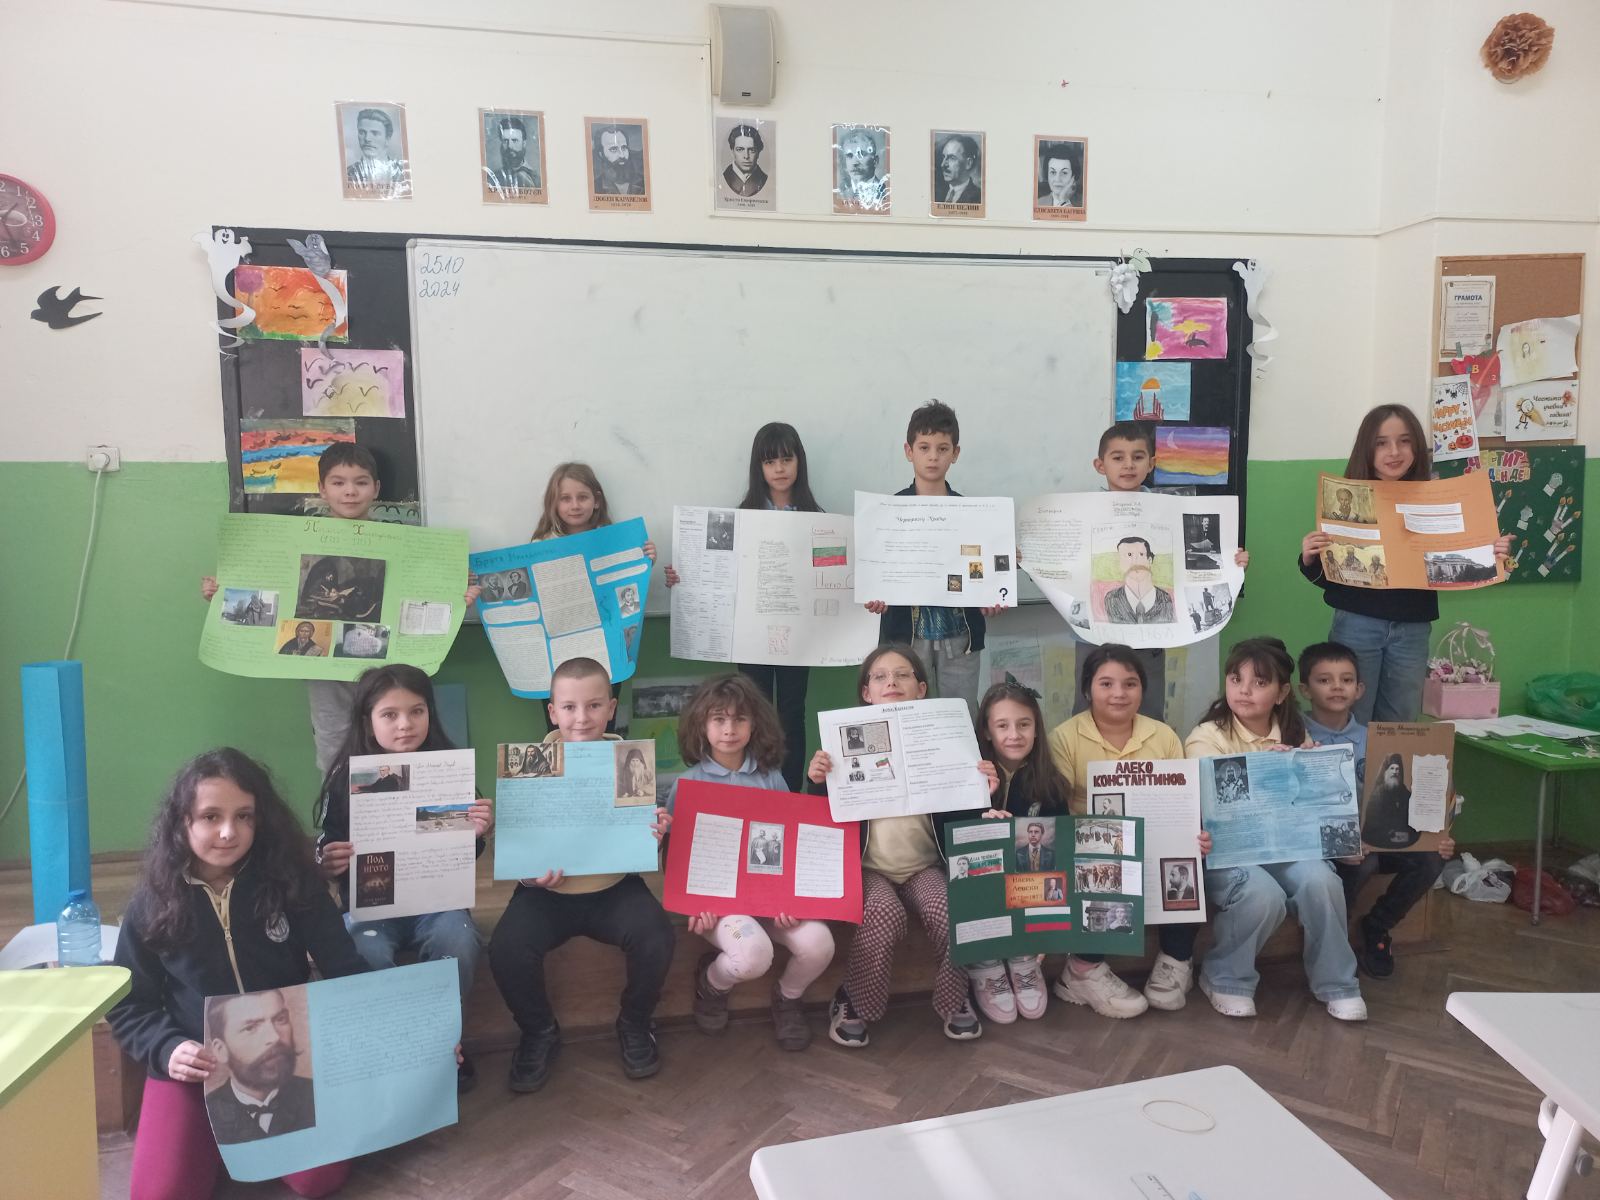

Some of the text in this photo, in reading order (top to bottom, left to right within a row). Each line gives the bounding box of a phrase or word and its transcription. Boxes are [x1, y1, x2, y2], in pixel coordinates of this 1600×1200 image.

[16, 186, 22, 197] 1
[28, 198, 36, 208] 2
[34, 215, 43, 226] 3
[32, 230, 40, 242] 4
[1, 246, 10, 258] 6
[20, 243, 29, 254] 5
[418, 279, 460, 298] 2024
[1454, 294, 1483, 302] ГРАМОТА
[1115, 761, 1154, 774] АЛЕКО
[1093, 772, 1187, 788] КОНСТАНТИНОВ
